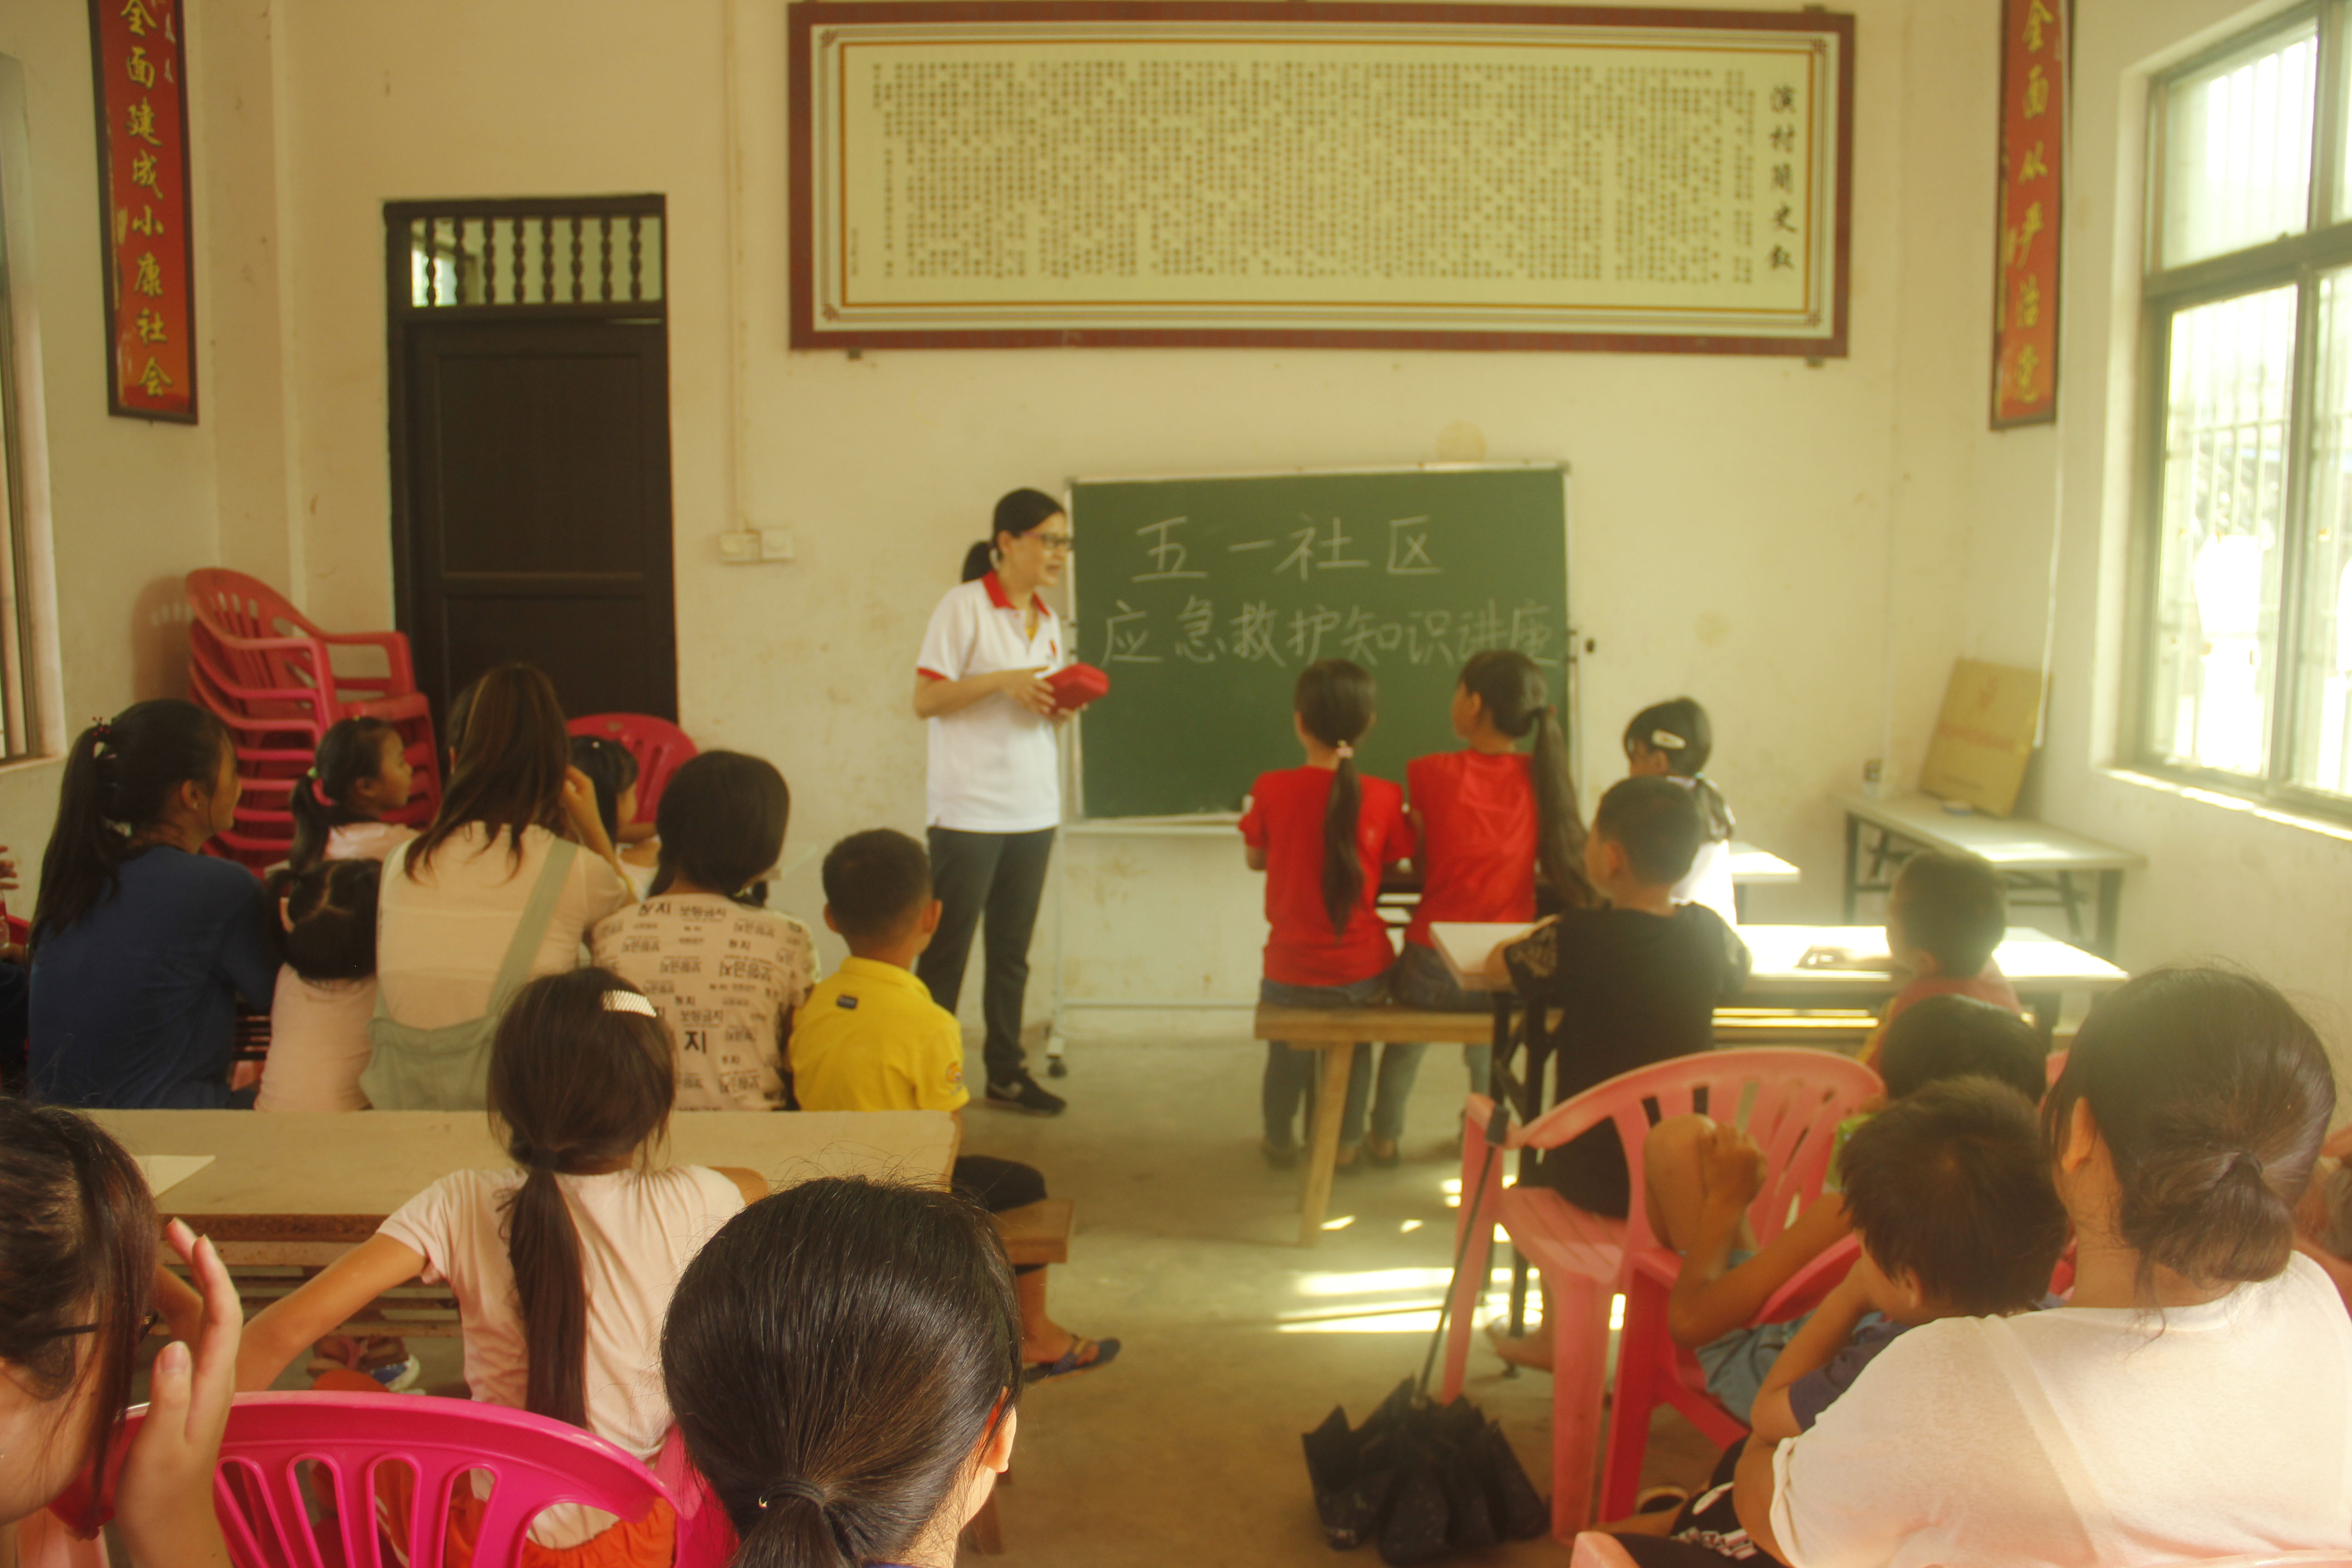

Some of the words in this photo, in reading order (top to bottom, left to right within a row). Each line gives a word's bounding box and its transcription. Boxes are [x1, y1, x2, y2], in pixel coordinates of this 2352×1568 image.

[120, 0, 172, 397] 全面建成小康社会
[1132, 514, 1444, 583] 五一社区
[1099, 593, 1560, 668] 应急救护知识讲座
